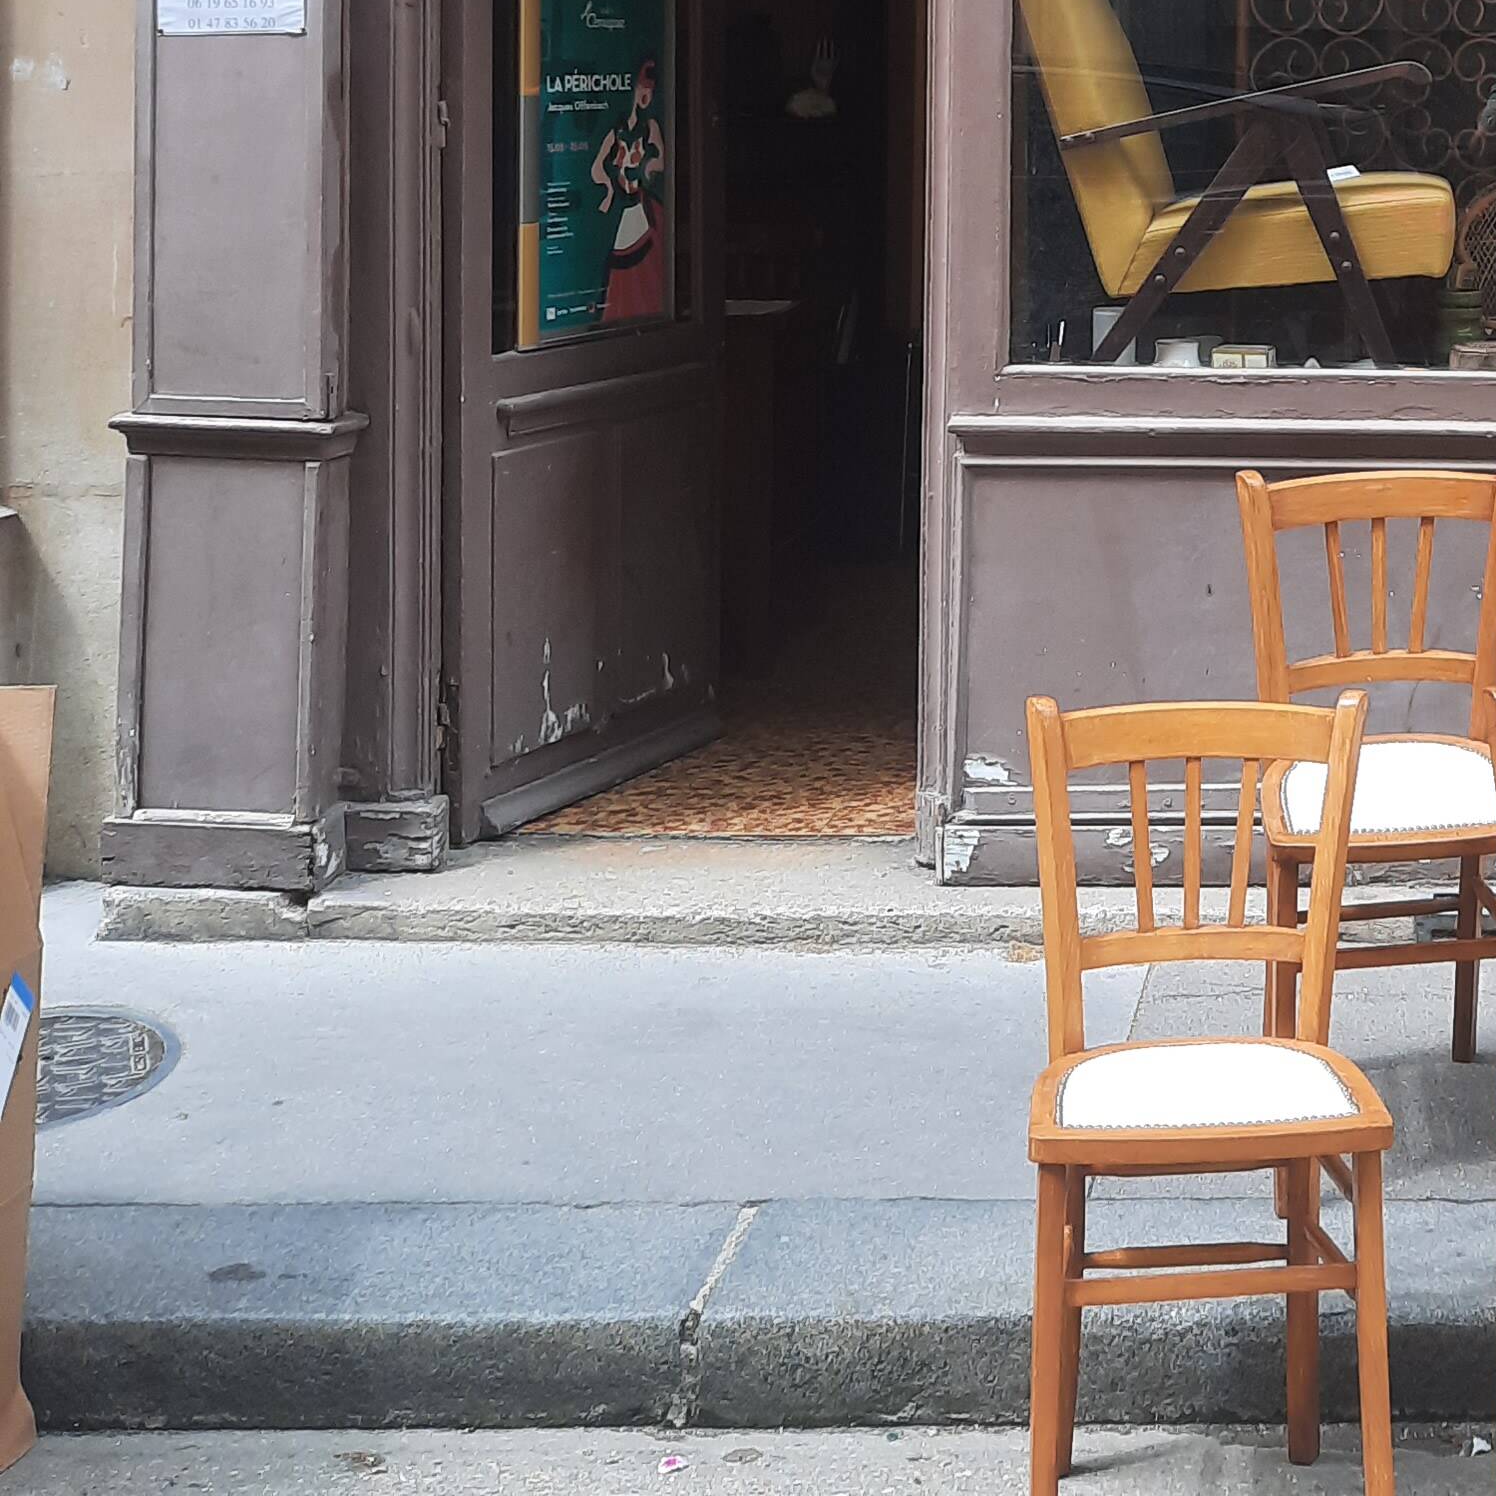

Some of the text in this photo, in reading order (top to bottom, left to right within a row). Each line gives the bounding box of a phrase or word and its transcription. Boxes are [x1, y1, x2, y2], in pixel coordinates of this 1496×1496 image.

[187, 17, 201, 29] 01
[206, 17, 220, 29] 47
[260, 16, 276, 28] 20
[546, 69, 632, 92] LA PÉRICHOLE
